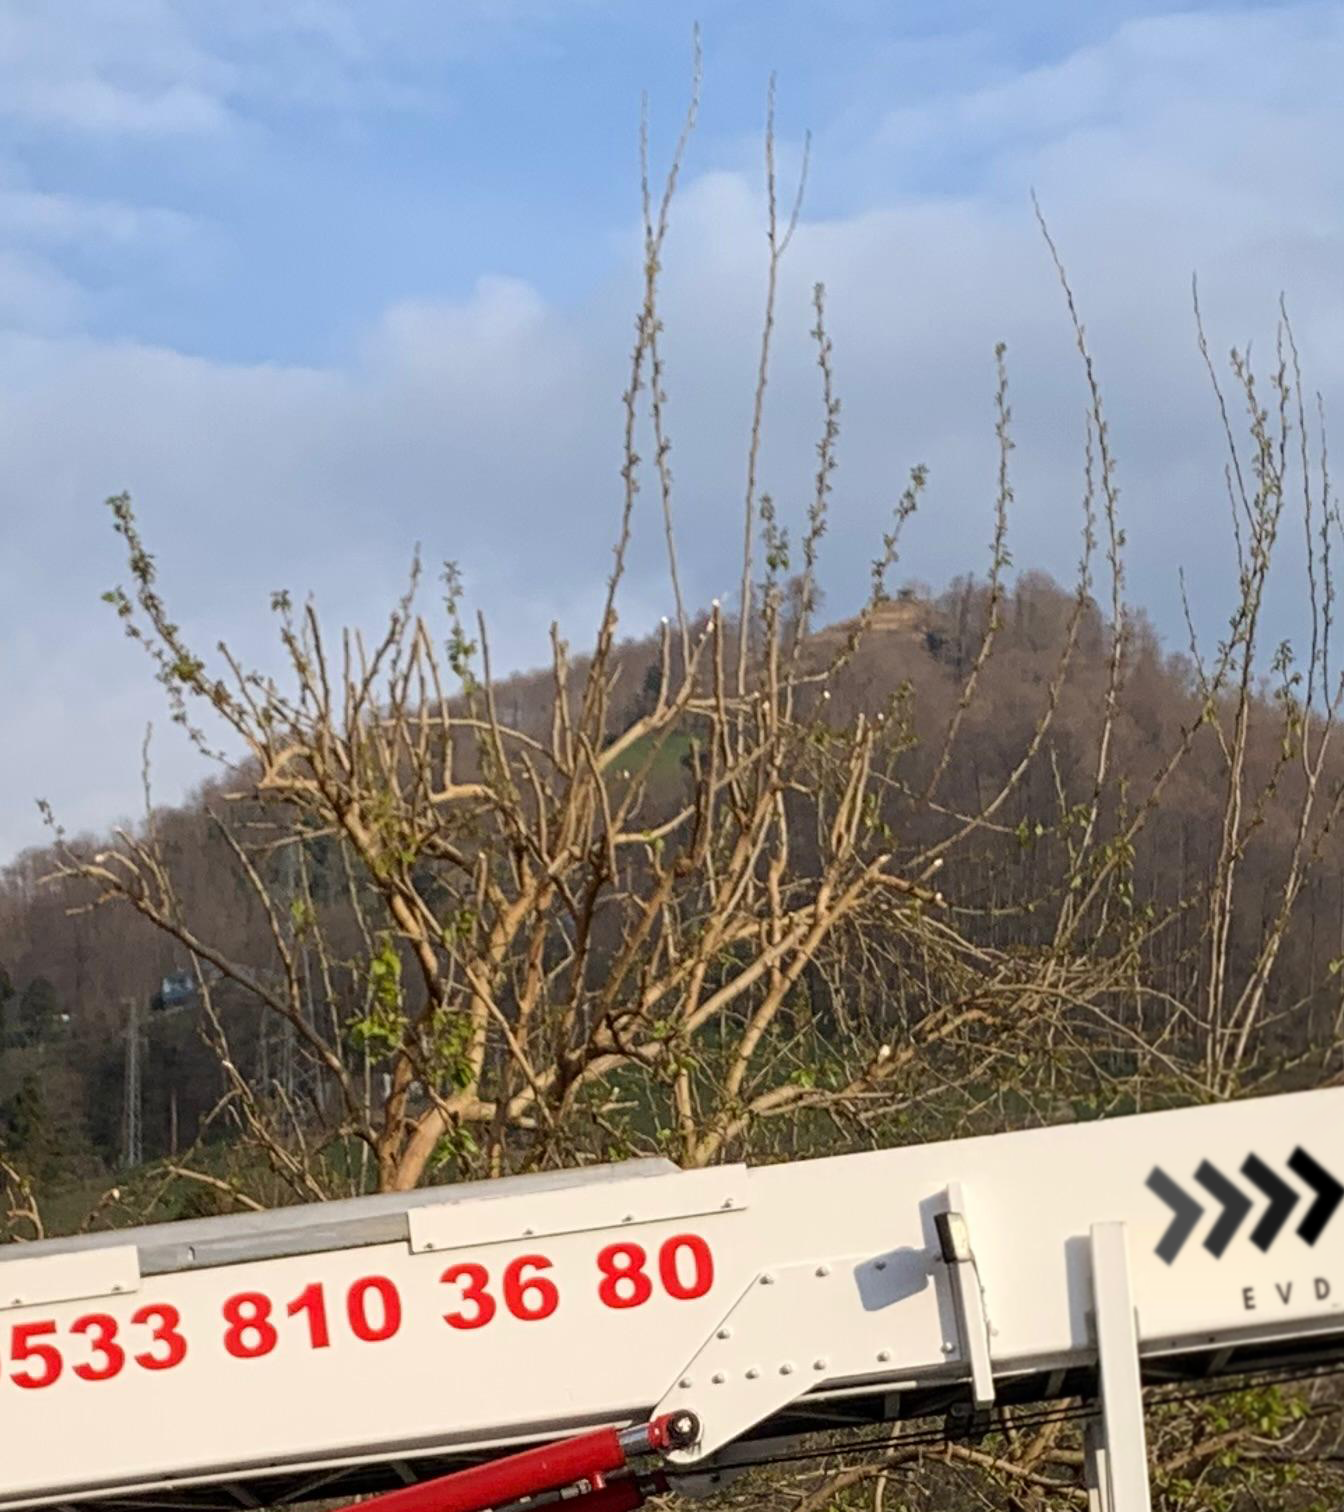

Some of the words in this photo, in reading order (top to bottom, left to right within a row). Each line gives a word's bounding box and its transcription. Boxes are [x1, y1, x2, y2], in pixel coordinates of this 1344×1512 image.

[222, 1275, 402, 1359] 810
[439, 1253, 560, 1331] 36
[595, 1233, 715, 1310] 80
